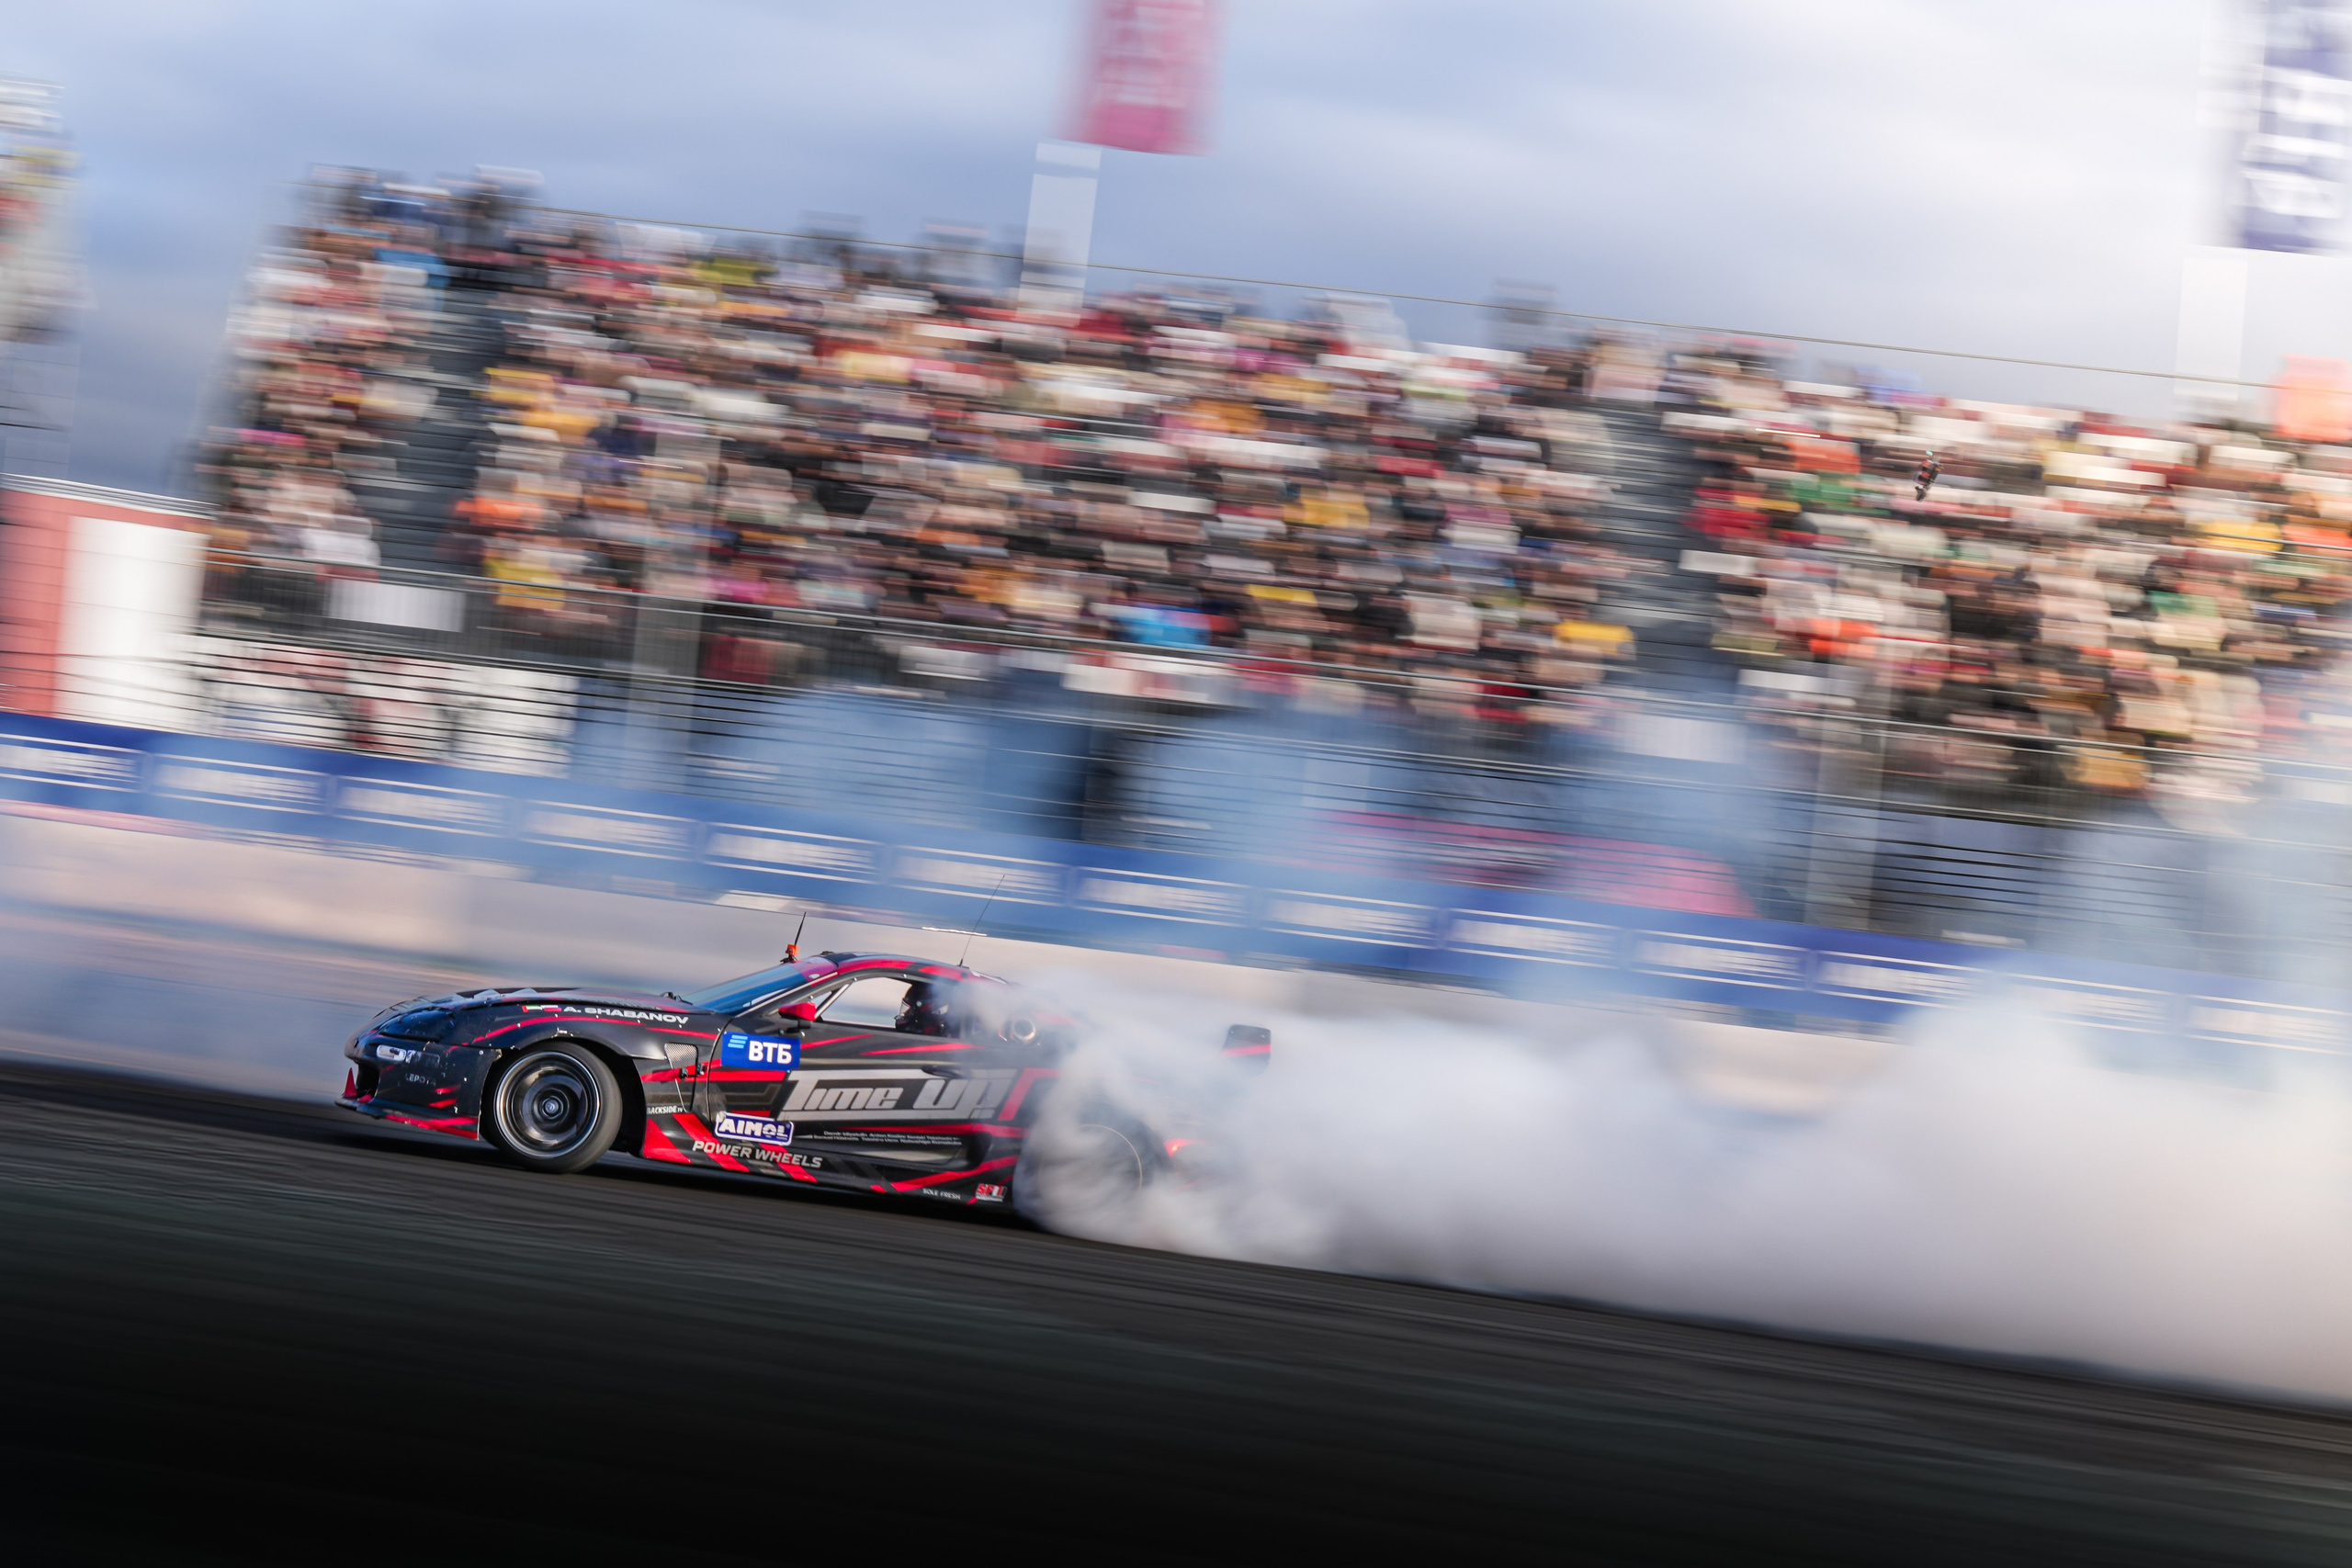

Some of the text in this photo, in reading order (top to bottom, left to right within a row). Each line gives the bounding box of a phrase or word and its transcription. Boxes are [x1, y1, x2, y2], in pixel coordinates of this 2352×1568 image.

[584, 1007, 689, 1025] SHABANOV
[748, 1040, 792, 1065] ВТБ
[647, 1105, 677, 1114] BACKSIDE
[718, 1118, 788, 1142] AIMOL
[693, 1141, 823, 1168] POWER WHEELS
